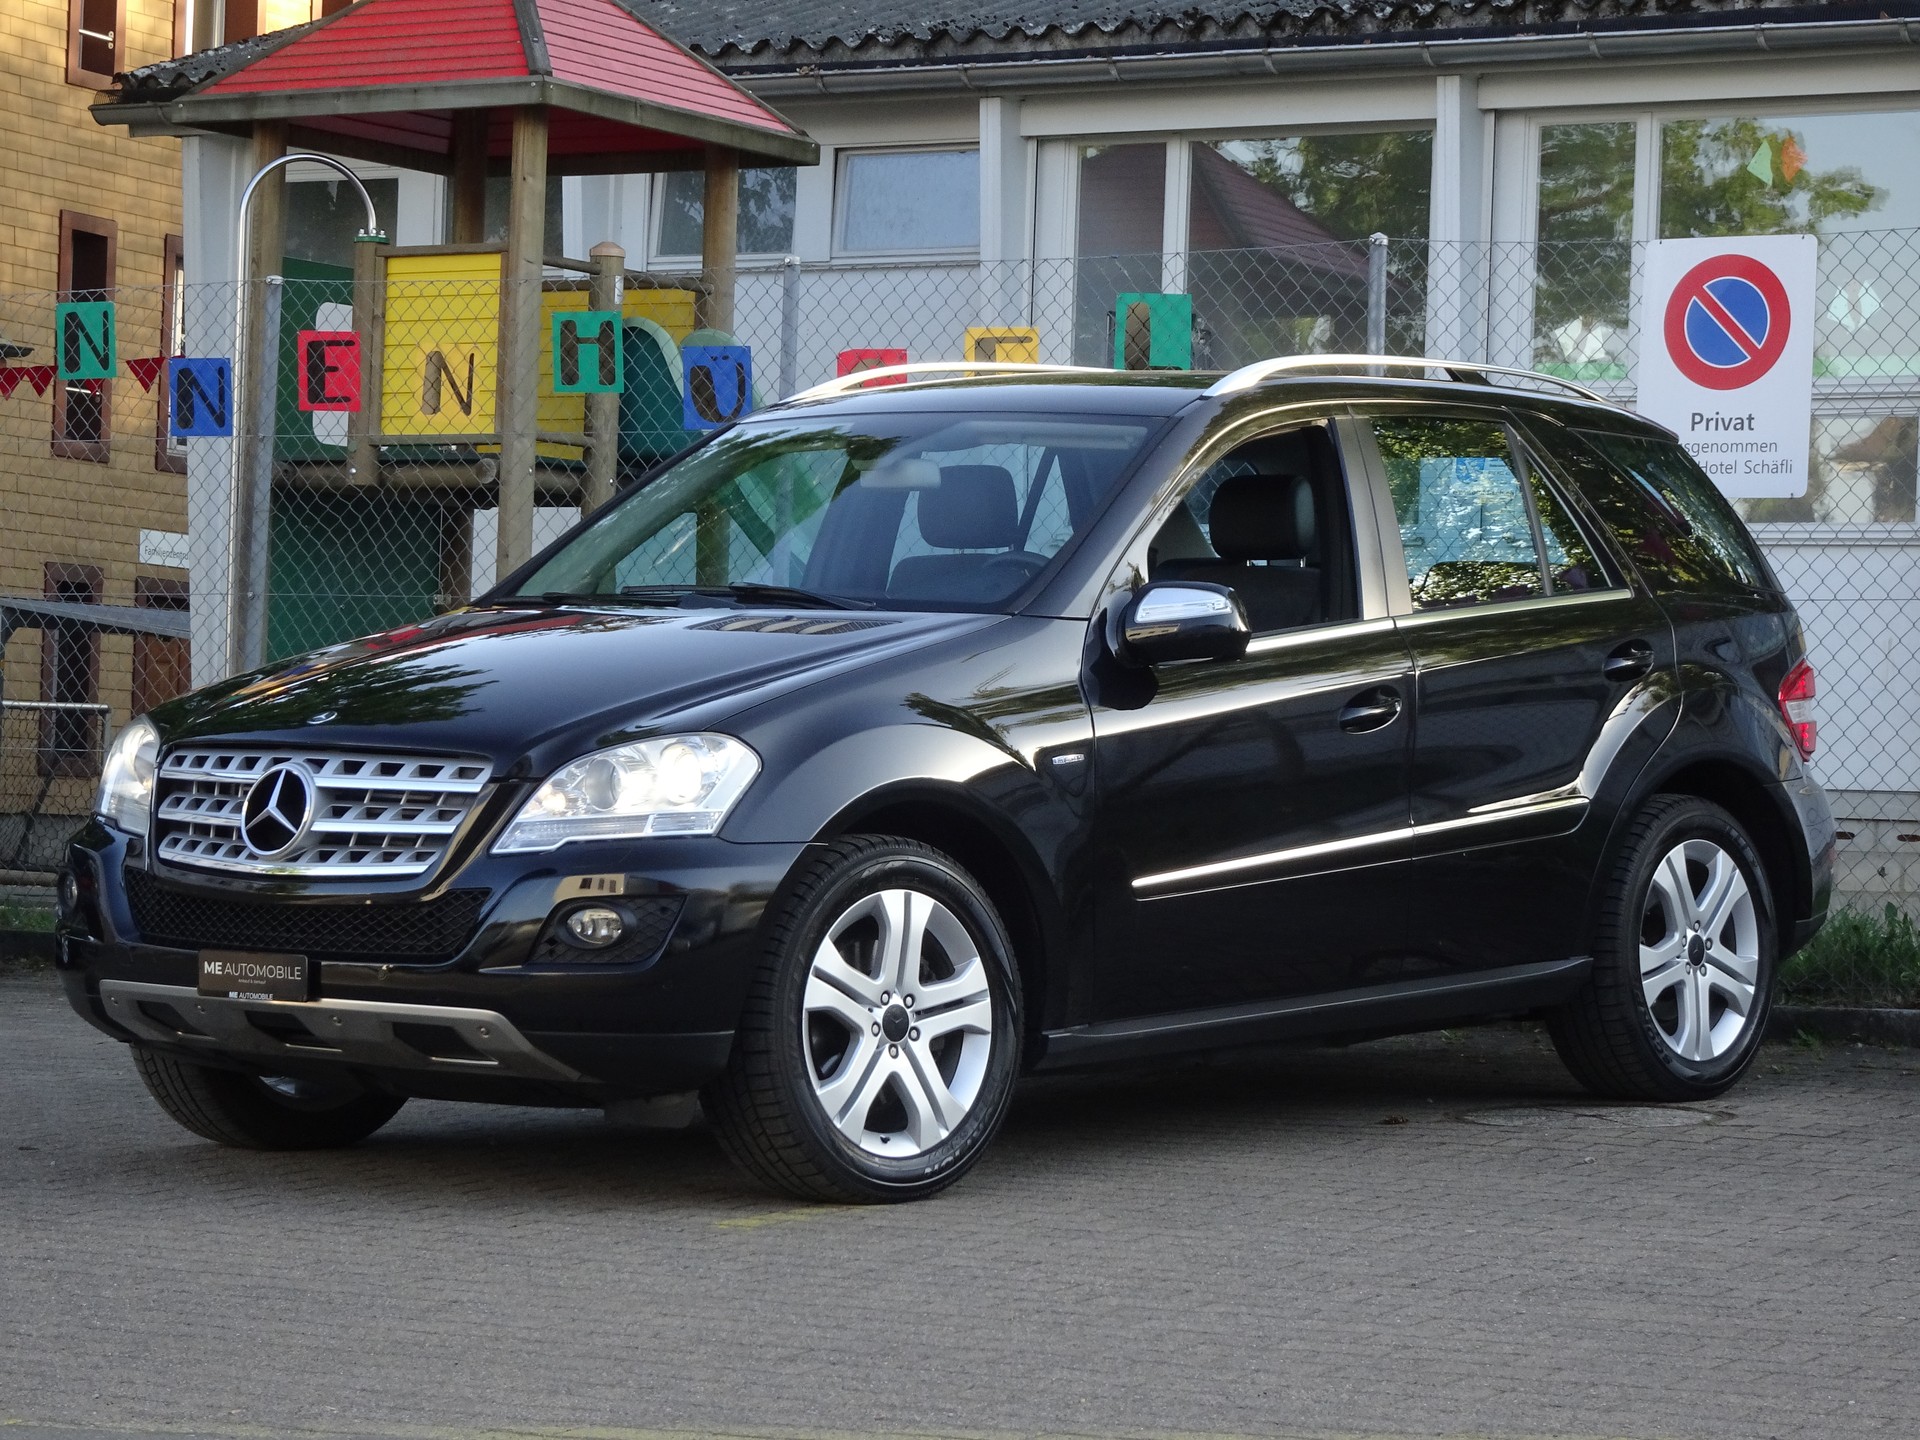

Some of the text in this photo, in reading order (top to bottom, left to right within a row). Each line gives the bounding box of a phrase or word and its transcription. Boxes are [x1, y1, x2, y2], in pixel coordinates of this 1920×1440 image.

[1690, 411, 1755, 432] Privat
[1681, 441, 1778, 458] sgenommen
[1743, 459, 1793, 475] Schäfli
[204, 961, 302, 980] ME AUTOMOBILE
[228, 991, 274, 1000] ME AUTOMOBILE
